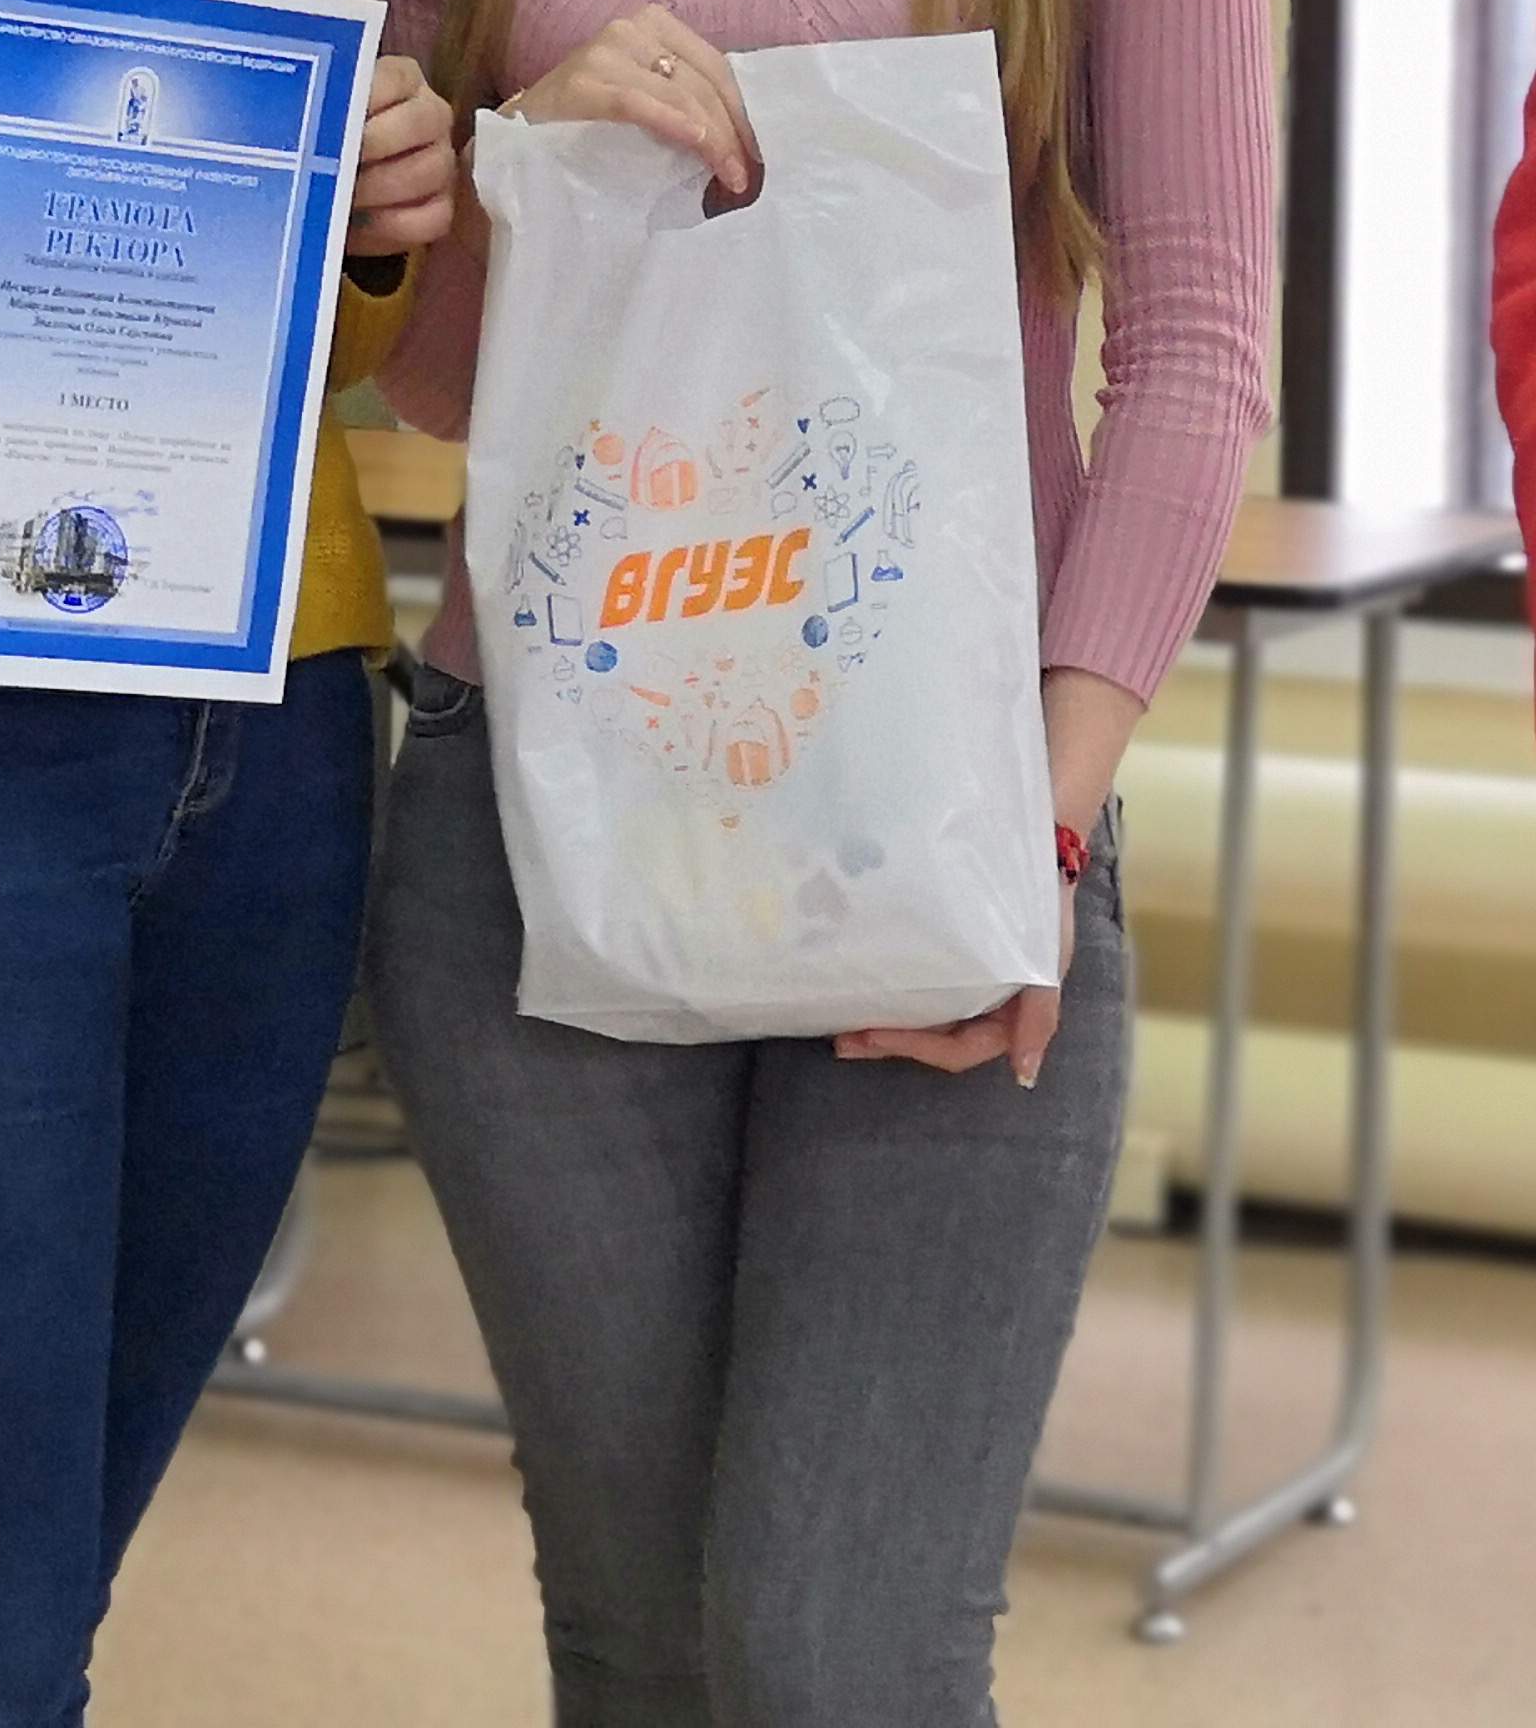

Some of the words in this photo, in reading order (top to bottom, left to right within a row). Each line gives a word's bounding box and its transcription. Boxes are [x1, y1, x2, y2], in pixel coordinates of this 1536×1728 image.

[44, 191, 196, 234] ГРАМОТА
[46, 228, 185, 268] РЕКТОРА
[71, 392, 130, 412] МЕСТО
[600, 528, 810, 628] ВГУЭС
